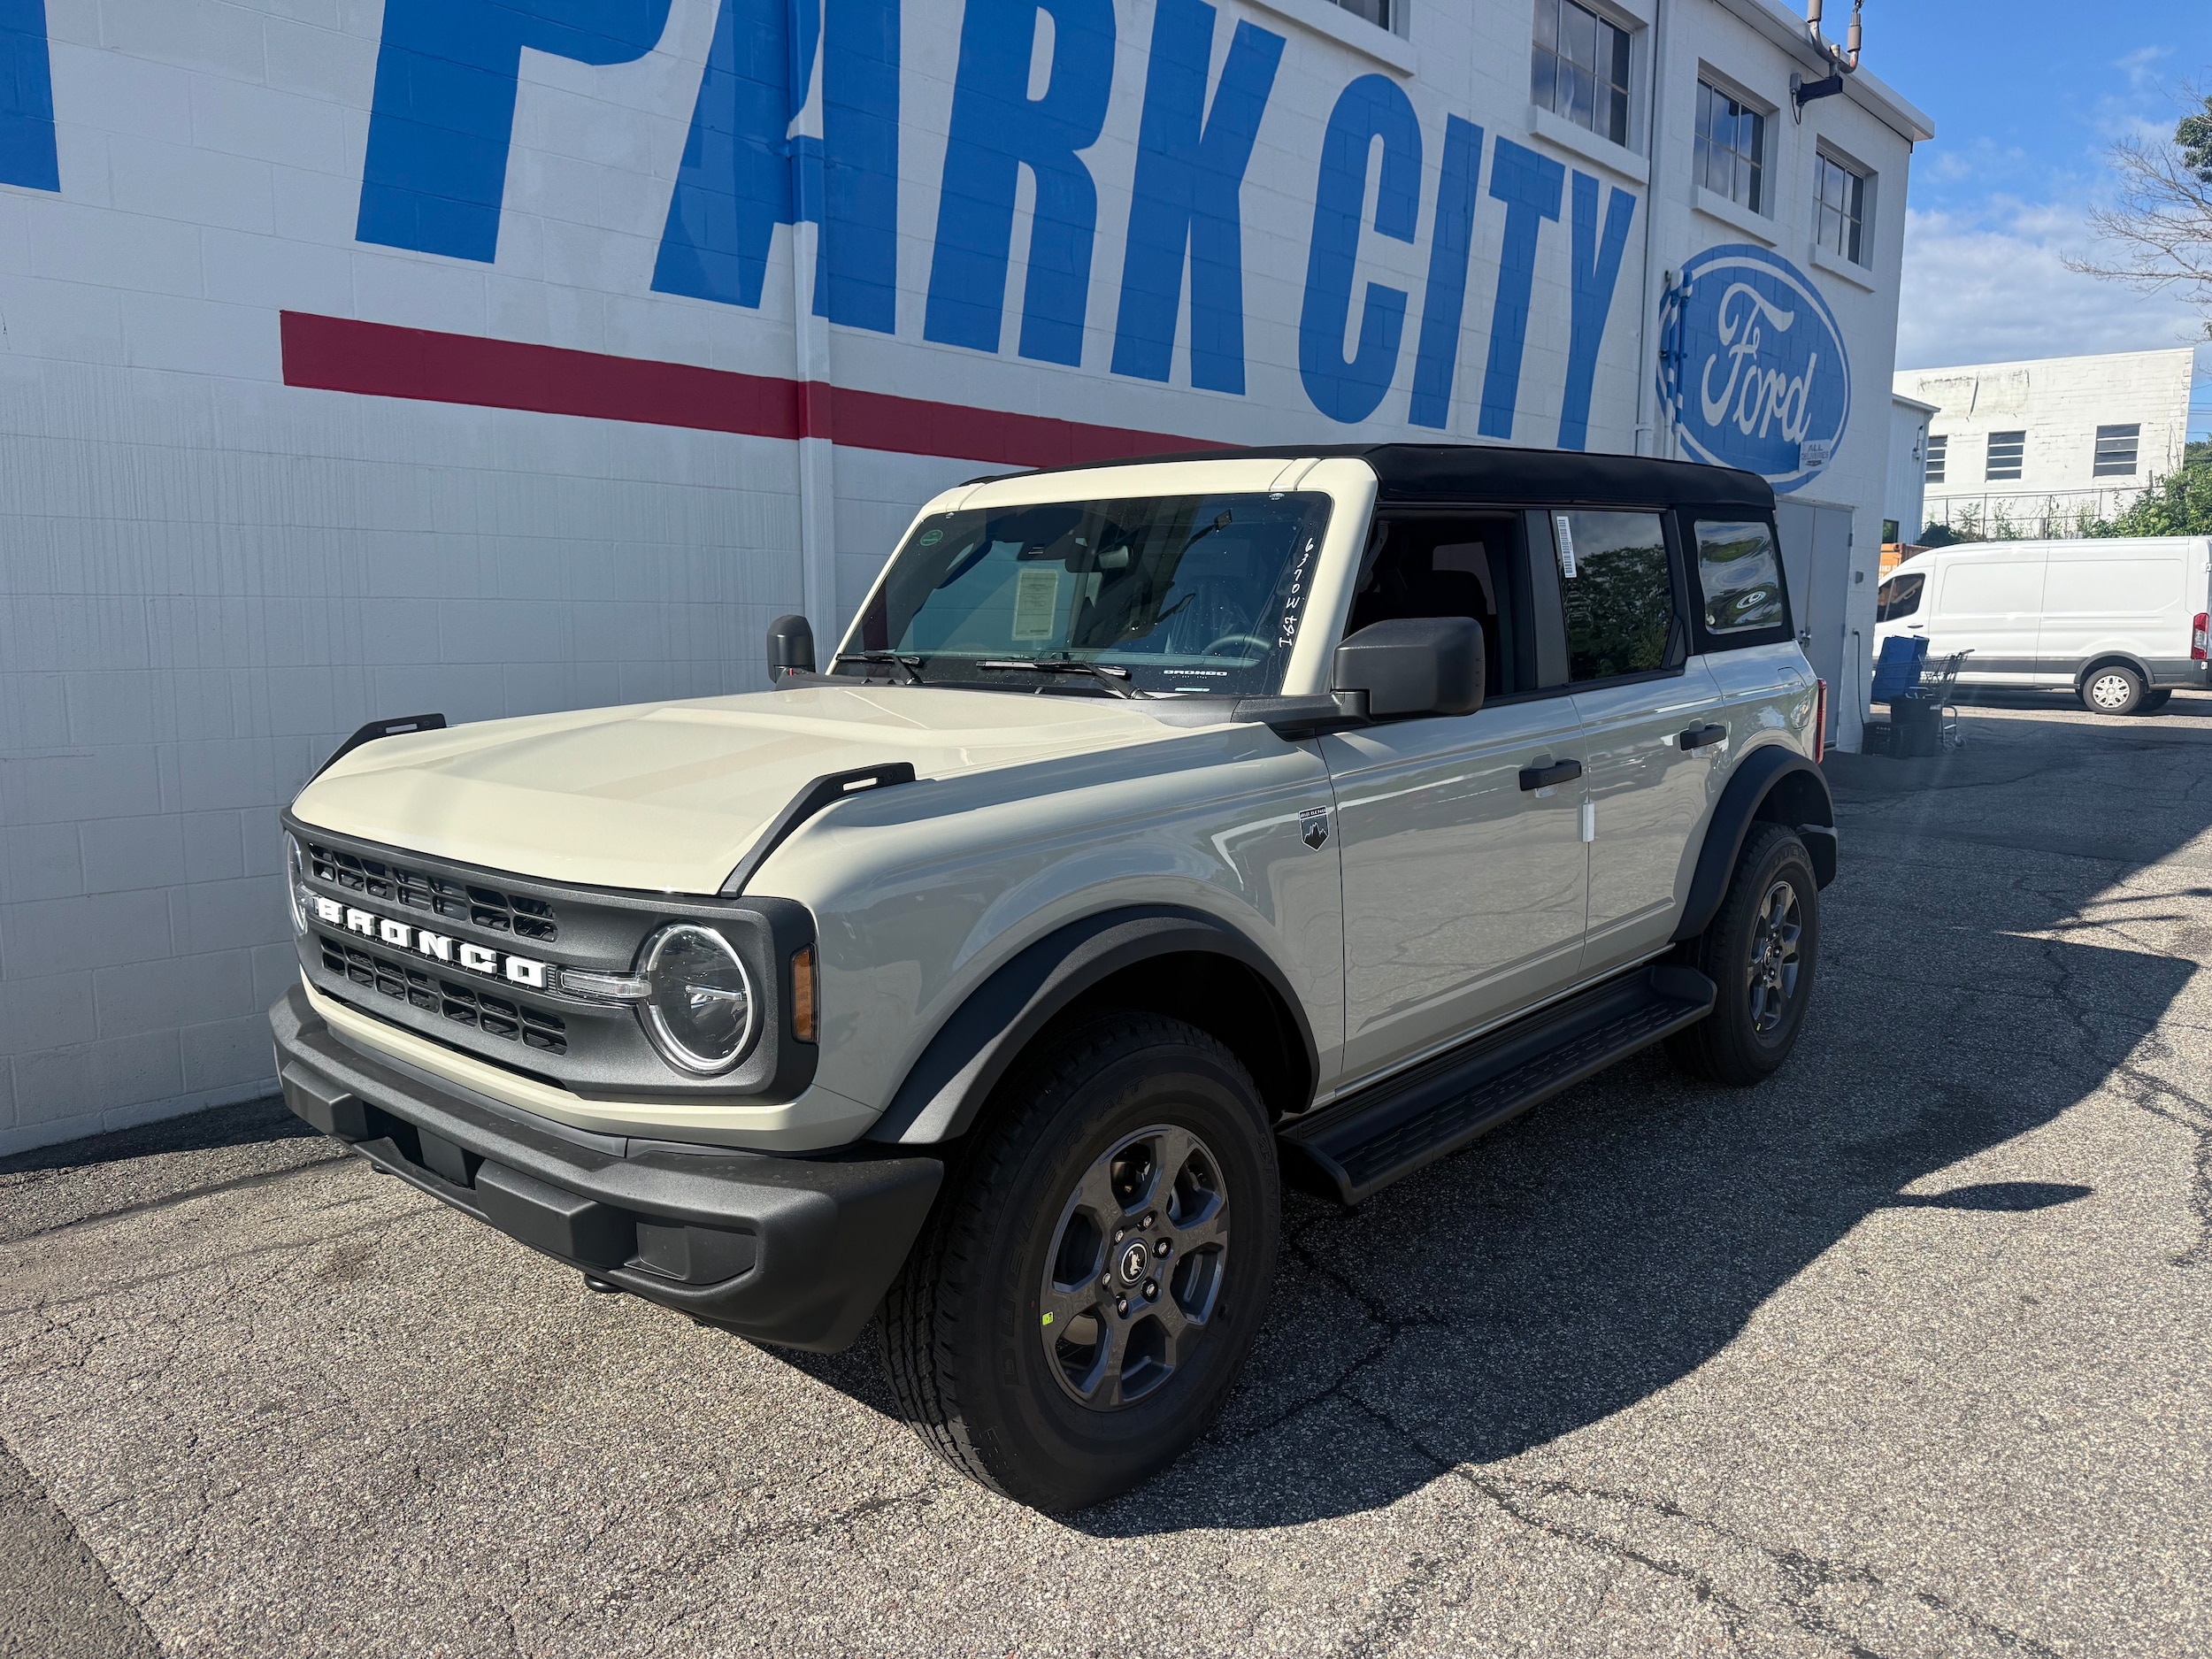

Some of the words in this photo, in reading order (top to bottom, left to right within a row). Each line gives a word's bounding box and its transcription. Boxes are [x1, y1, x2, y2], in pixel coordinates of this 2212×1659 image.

[1298, 72, 1637, 451] CITY
[1701, 282, 1817, 445] Ford
[319, 897, 547, 988] BRONCO
